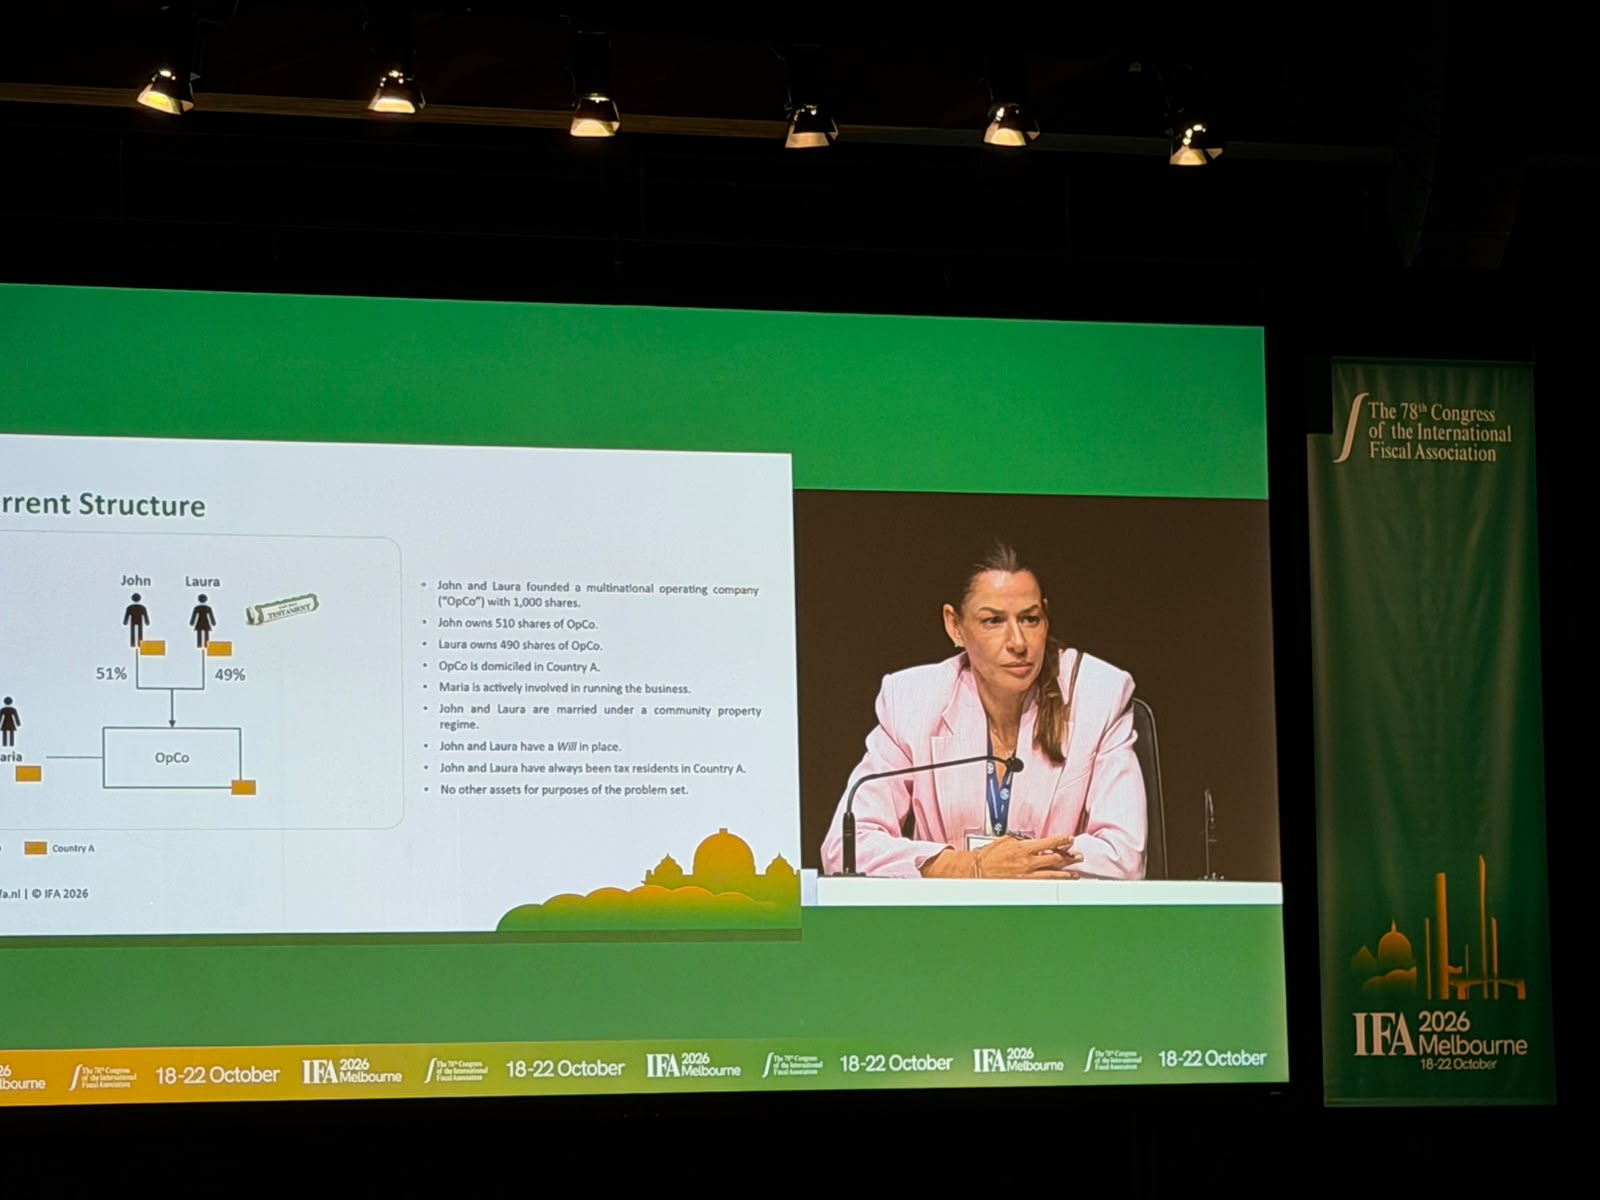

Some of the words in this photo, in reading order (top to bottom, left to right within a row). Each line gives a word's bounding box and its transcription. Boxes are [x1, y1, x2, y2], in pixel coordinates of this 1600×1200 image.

[1368, 401, 1397, 420] The
[1400, 402, 1428, 420] 78th
[1431, 403, 1496, 425] Congress
[1368, 420, 1385, 440] of
[1391, 422, 1413, 440] the
[1417, 423, 1512, 443] International
[1369, 441, 1411, 459] Fiscal
[1414, 442, 1497, 462] Association
[2, 494, 71, 514] rrent
[79, 492, 206, 517] Structure
[120, 574, 151, 586] John
[185, 576, 220, 587] Laura
[437, 579, 463, 591] John
[466, 580, 488, 592] and
[492, 581, 522, 592] Laura
[526, 581, 570, 593] founded
[574, 584, 582, 593] a
[586, 582, 654, 594] multinational
[658, 584, 709, 597] operating
[712, 586, 760, 598] company
[487, 596, 511, 607] with
[513, 597, 543, 609] 1,000
[544, 597, 582, 608] shares.
[437, 617, 463, 628] John
[464, 619, 493, 629] owns
[495, 617, 516, 629] 510
[517, 618, 551, 629] shares
[553, 618, 565, 630] of
[566, 618, 599, 631] OpCo.
[438, 638, 468, 650] Laura
[469, 640, 498, 650] owns
[499, 639, 521, 650] 490
[522, 639, 556, 651] shares
[557, 640, 569, 651] of
[571, 640, 603, 653] OpCo.
[96, 667, 127, 680] 51%
[438, 660, 469, 673] OpCo
[480, 660, 532, 672] domiciled
[534, 662, 544, 672] in
[546, 661, 588, 674] Country
[589, 662, 601, 673] A.
[215, 668, 246, 681] 49%
[439, 681, 470, 693] Maria
[472, 682, 481, 693] is
[482, 682, 523, 695] actively
[524, 682, 569, 693] involved
[570, 683, 581, 693] in
[583, 683, 623, 696] running
[624, 683, 643, 694] the
[644, 683, 692, 694] business.
[439, 703, 465, 714] John
[470, 703, 491, 714] and
[497, 703, 526, 714] Laura
[532, 706, 550, 715] are
[556, 703, 598, 715] married
[603, 704, 635, 715] under
[640, 706, 648, 715] a
[653, 705, 712, 718] community
[717, 707, 762, 718] property
[439, 719, 480, 732] regime.
[439, 740, 465, 752] John
[466, 741, 487, 752] and
[489, 741, 518, 752] Laura
[520, 741, 546, 752] have
[547, 743, 555, 752] a
[557, 741, 578, 752] Will
[579, 742, 589, 752] in
[591, 741, 622, 754] place.
[0, 751, 22, 762] aria
[155, 752, 190, 766] OpCo
[439, 762, 465, 773] John
[467, 762, 487, 773] and
[489, 762, 519, 773] Laura
[520, 762, 546, 773] have
[548, 762, 584, 776] always
[585, 762, 612, 773] been
[613, 764, 630, 773] tax
[632, 762, 679, 774] residents
[681, 763, 691, 773] in
[693, 763, 734, 776] Country
[735, 763, 747, 774] A.
[440, 784, 457, 795] No
[458, 783, 488, 795] other
[489, 785, 522, 795] assets
[523, 783, 540, 795] for
[541, 786, 590, 797] purposes
[591, 783, 603, 795] of
[604, 784, 622, 795] the
[624, 784, 668, 797] problem
[669, 785, 689, 796] set.
[52, 844, 86, 854] Country
[88, 844, 95, 853] A
[45, 888, 61, 899] IFA
[63, 888, 89, 899] 2026
[1418, 1010, 1471, 1032] 2026
[1352, 1011, 1417, 1056] IFA
[1418, 1034, 1528, 1056] Melbourne
[681, 1052, 710, 1065] 2026
[973, 1048, 1006, 1073] IFA
[1006, 1047, 1034, 1060] 2026
[1158, 1050, 1202, 1067] 18-22
[1205, 1049, 1267, 1066] October
[339, 1058, 370, 1072] 2026
[506, 1060, 554, 1078] 18-22
[557, 1059, 626, 1077] October
[646, 1053, 681, 1078] IFA
[681, 1063, 742, 1077] Melbourne
[840, 1054, 886, 1073] 18-22
[889, 1054, 954, 1072] October
[1006, 1059, 1064, 1072] Melbourne
[1420, 1058, 1452, 1070] 18-22
[1453, 1057, 1498, 1070] October
[155, 1066, 206, 1085] 18-22
[209, 1065, 280, 1084] October
[302, 1059, 339, 1084] IFA
[339, 1069, 403, 1084] Melbourne
